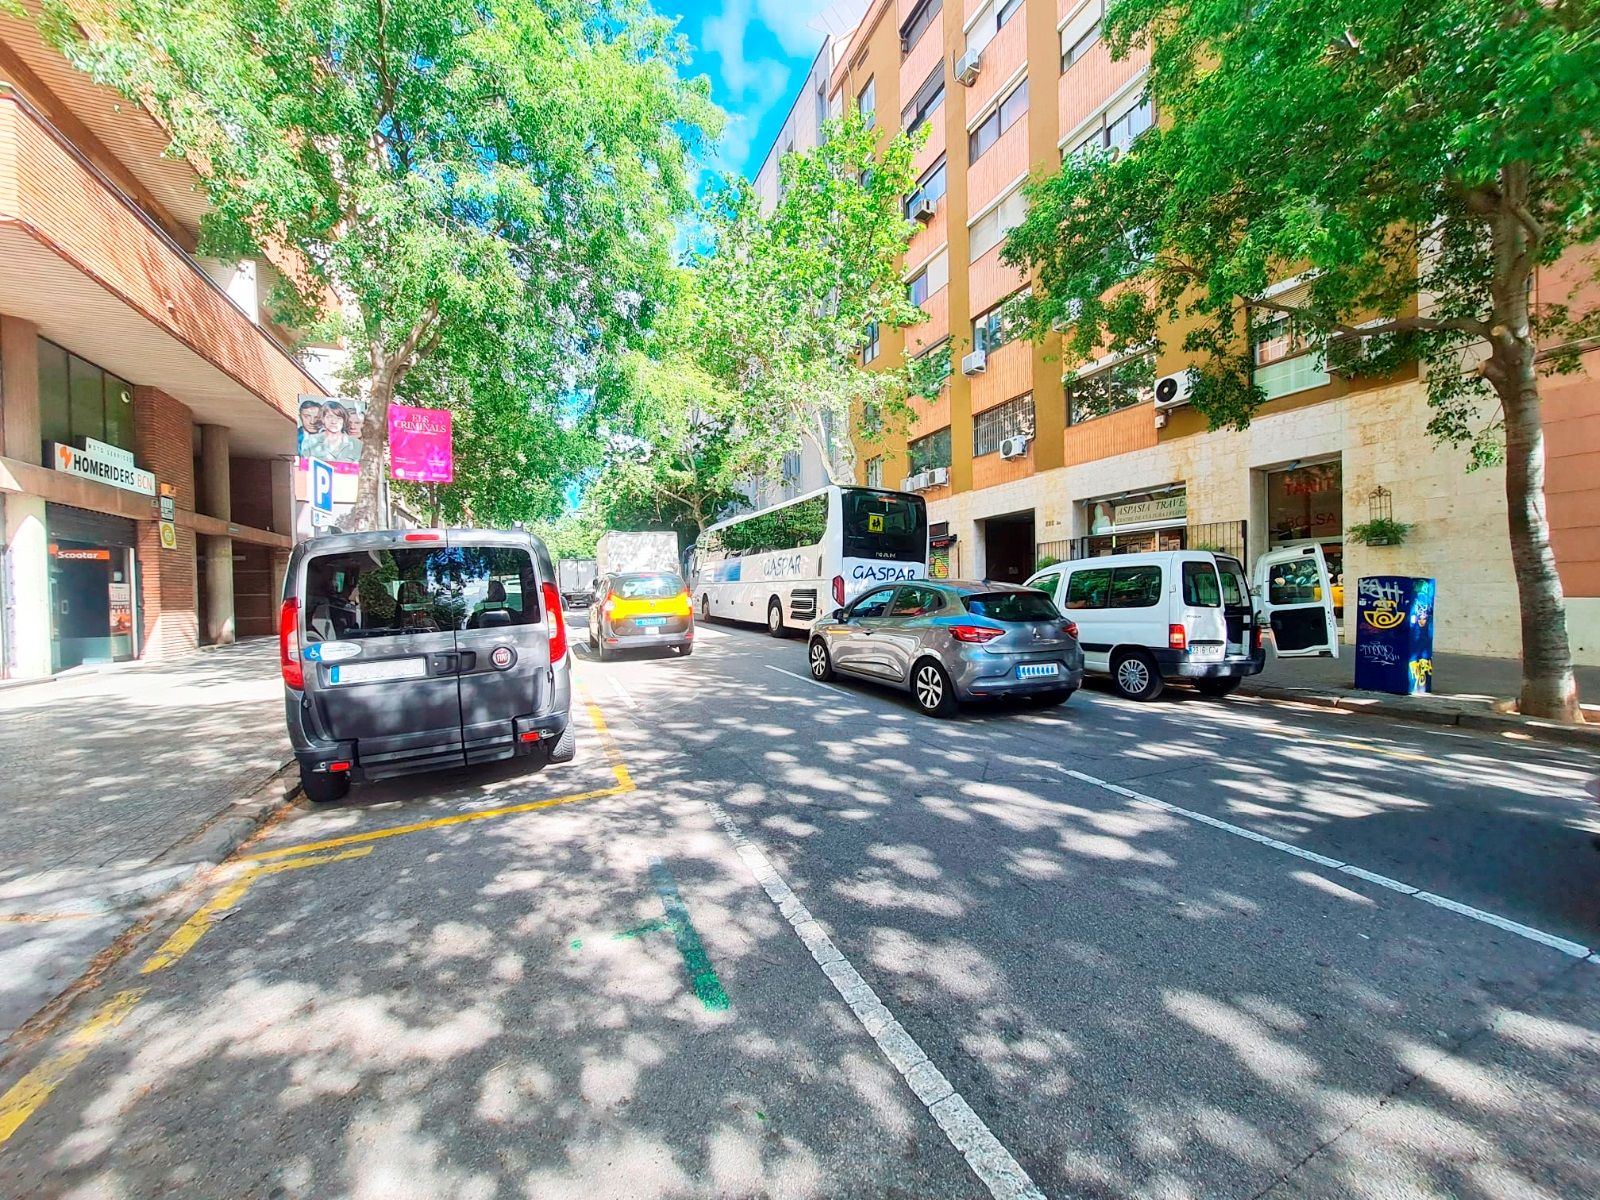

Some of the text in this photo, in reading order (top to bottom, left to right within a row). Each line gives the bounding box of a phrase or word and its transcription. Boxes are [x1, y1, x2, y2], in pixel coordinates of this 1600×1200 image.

[394, 420, 447, 433] CRIMINALS
[412, 414, 430, 423] ELS
[73, 454, 153, 492] HOMERIDERS BCN
[316, 465, 331, 505] P
[1117, 498, 1186, 516] ASPASIA TRAVE
[1287, 512, 1337, 528] BOLSA
[58, 551, 98, 559] Scooter
[763, 555, 802, 577] GASPAR
[853, 565, 916, 581] GASPAR
